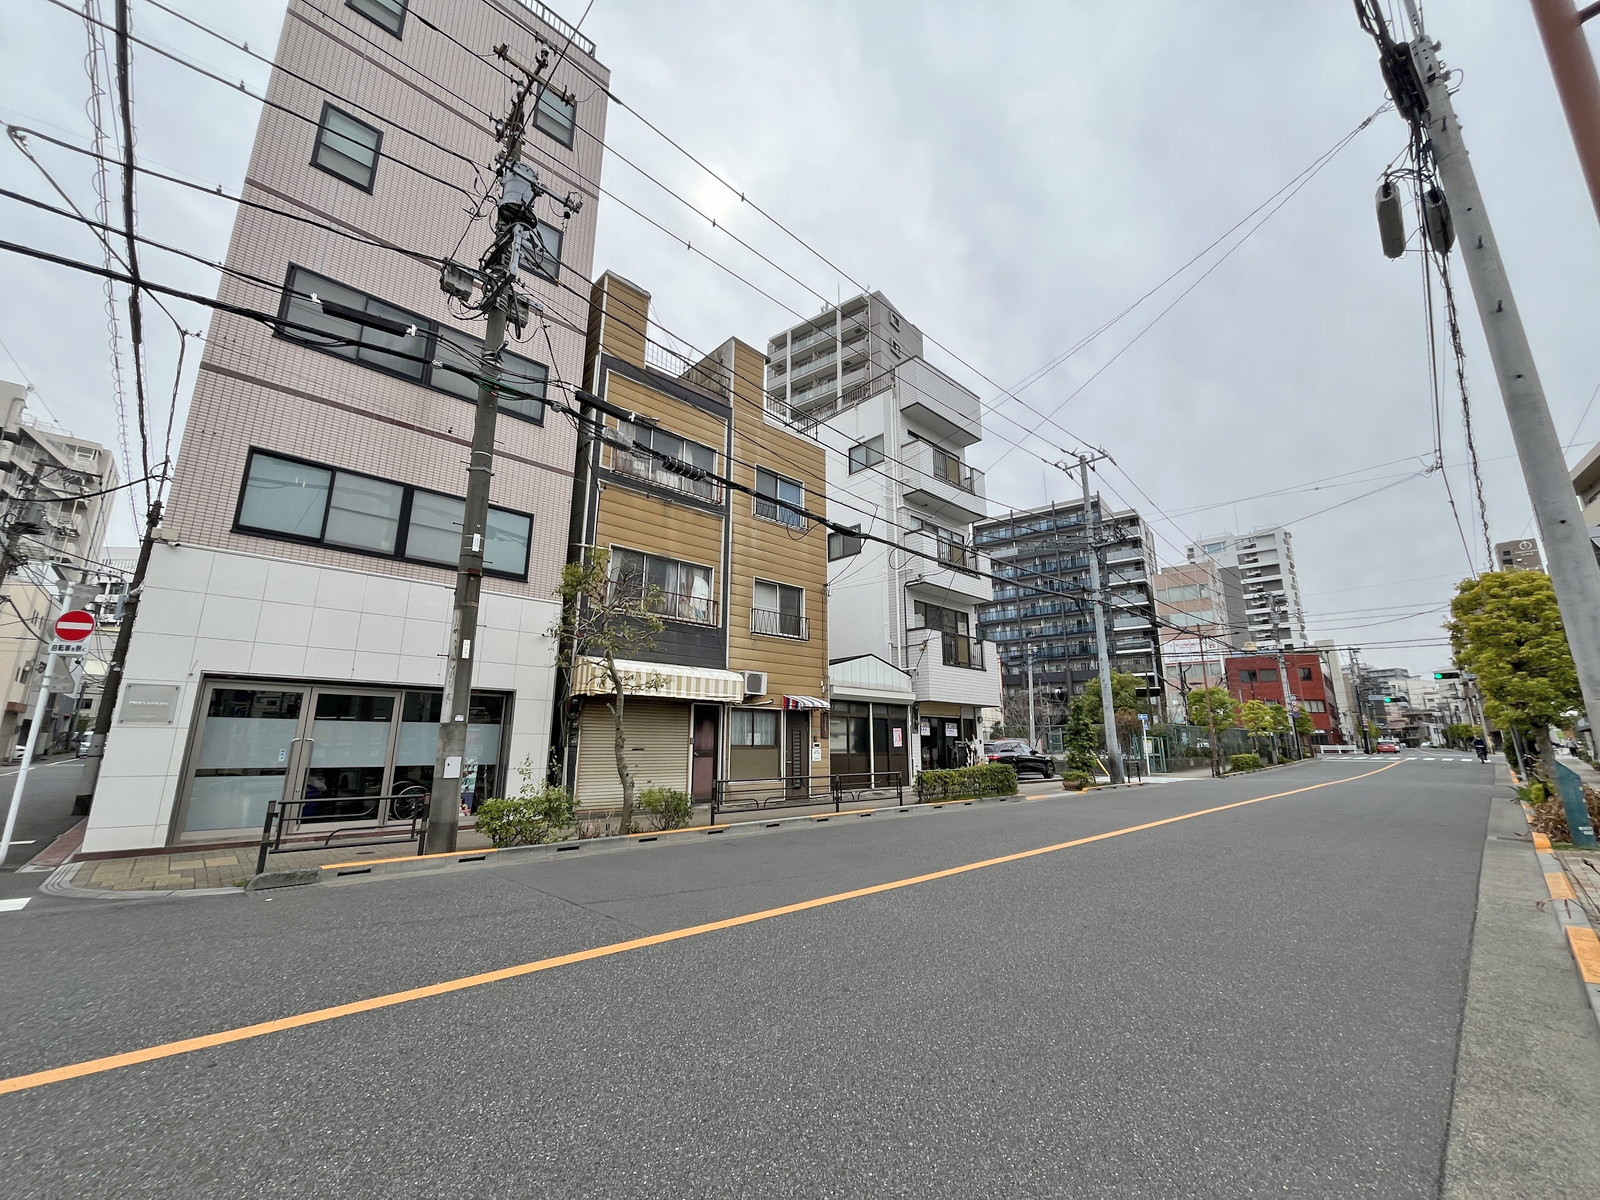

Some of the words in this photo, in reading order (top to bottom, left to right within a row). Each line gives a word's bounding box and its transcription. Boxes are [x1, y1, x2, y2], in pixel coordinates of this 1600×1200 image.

[51, 644, 86, 652] 自転車を除く
